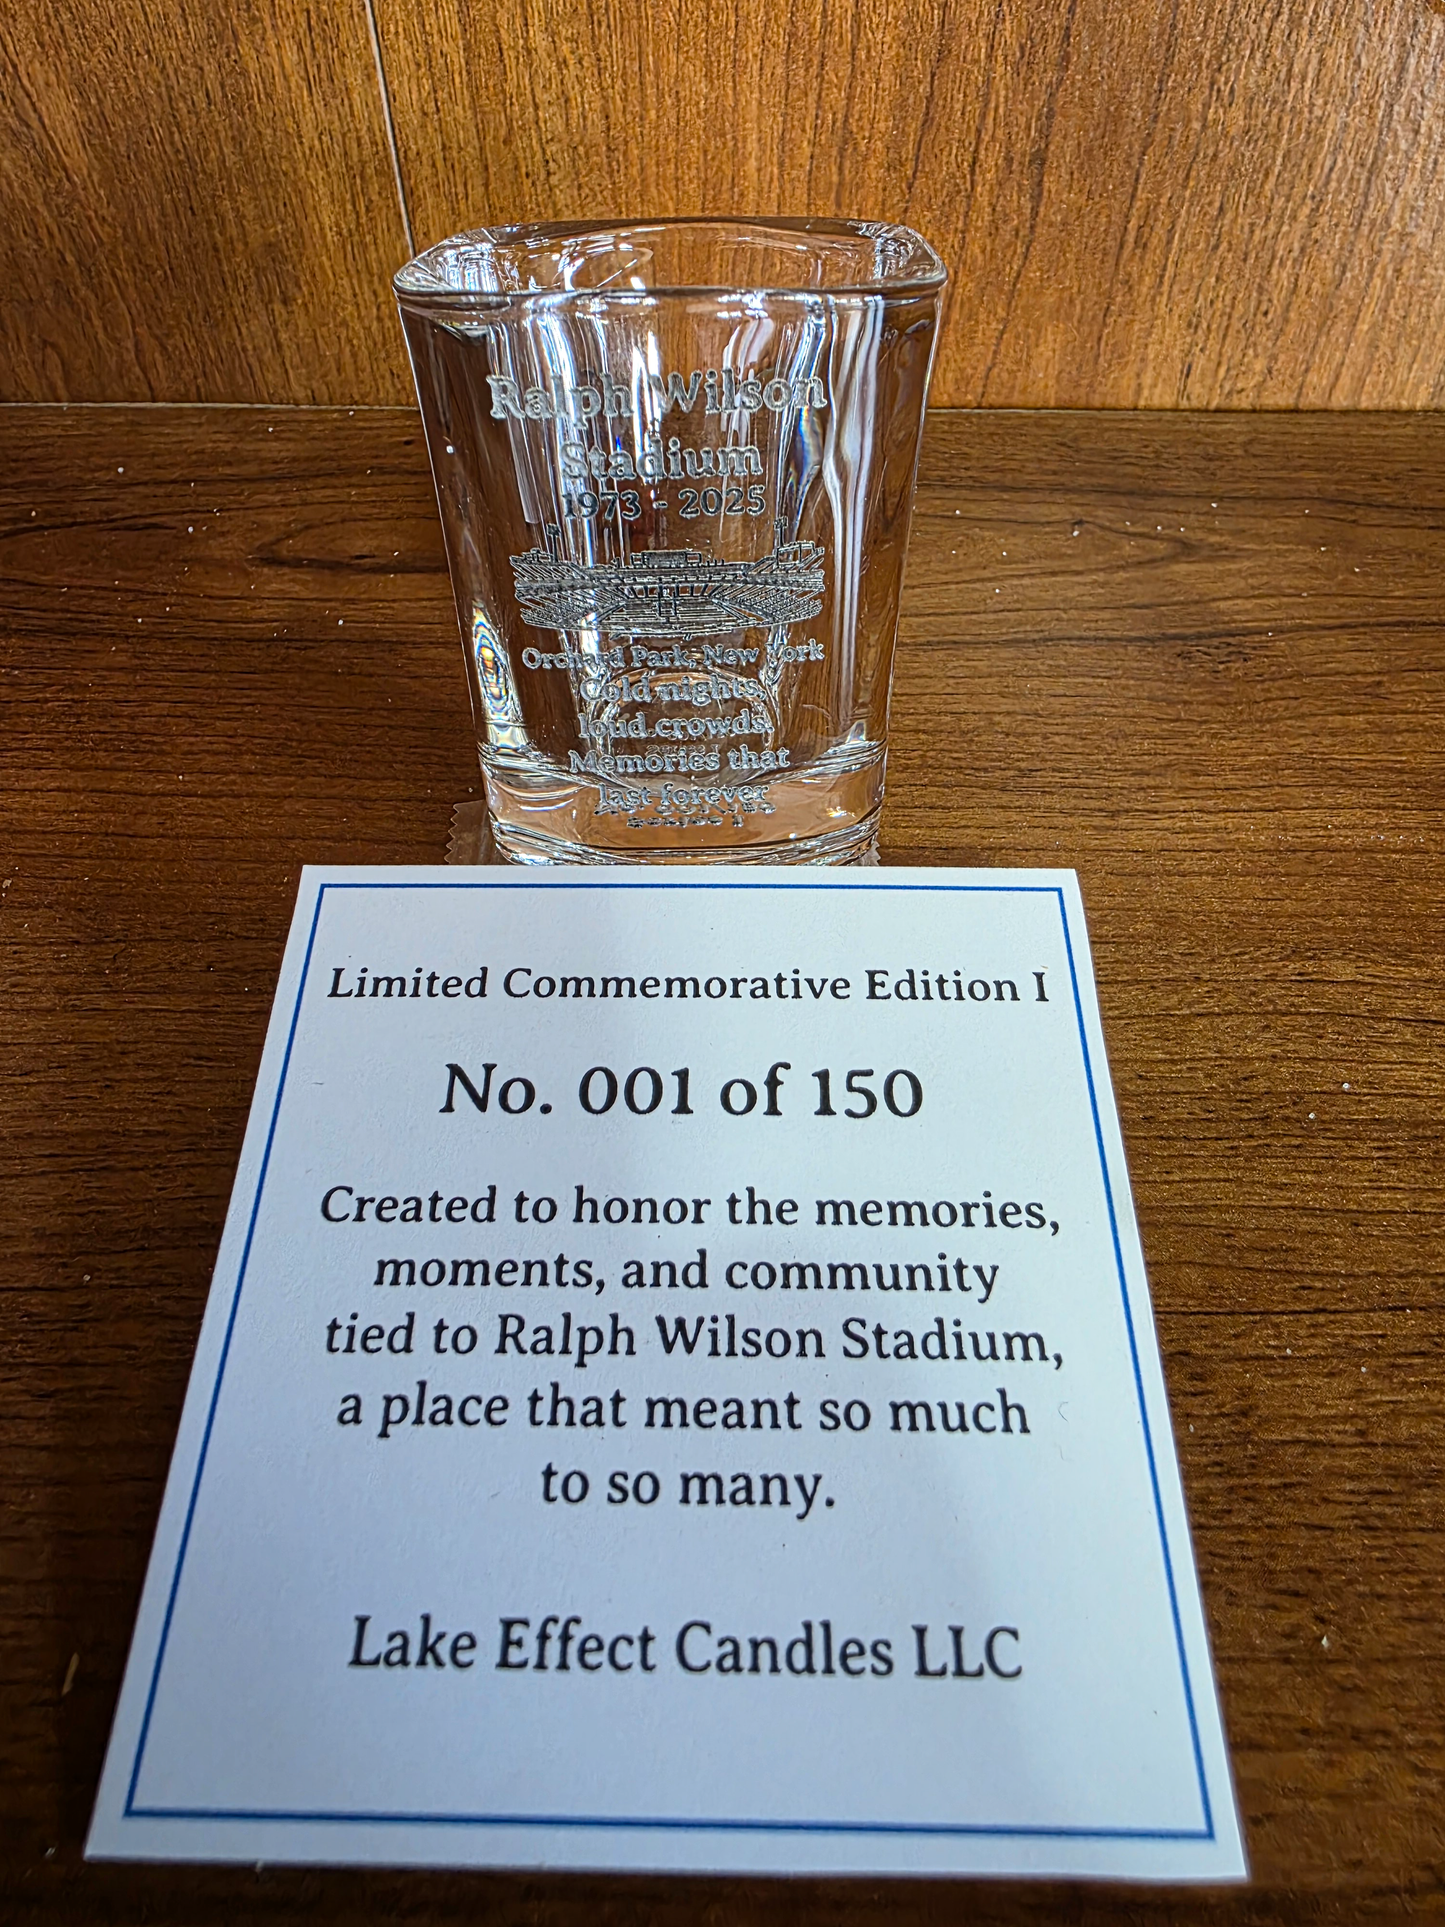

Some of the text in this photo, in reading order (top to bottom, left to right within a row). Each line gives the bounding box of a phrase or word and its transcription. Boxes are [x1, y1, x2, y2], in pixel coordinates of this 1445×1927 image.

[486, 367, 828, 430] Ralph Wilson
[560, 436, 765, 482] Stadium
[561, 489, 642, 521] 1973
[678, 485, 766, 520] 2025
[521, 645, 625, 672] Orchard
[628, 643, 698, 669] Park,
[699, 643, 760, 667] New
[579, 674, 768, 707] Cold nights,
[568, 743, 791, 774] Memories that
[598, 781, 771, 807] last forever
[326, 965, 1050, 1003] Limited Commemorative Edition I
[438, 1061, 924, 1120] No. 001 of 150
[320, 1184, 1060, 1237] Created to honor the memories,
[372, 1247, 1000, 1305] moments, and community
[325, 1311, 1063, 1371] tied to Ralph Wilson Stadium,
[336, 1379, 1031, 1440] a place that meant so much
[541, 1461, 835, 1521] to so many.
[347, 1612, 1023, 1680] Lake Effect Candles LLC
